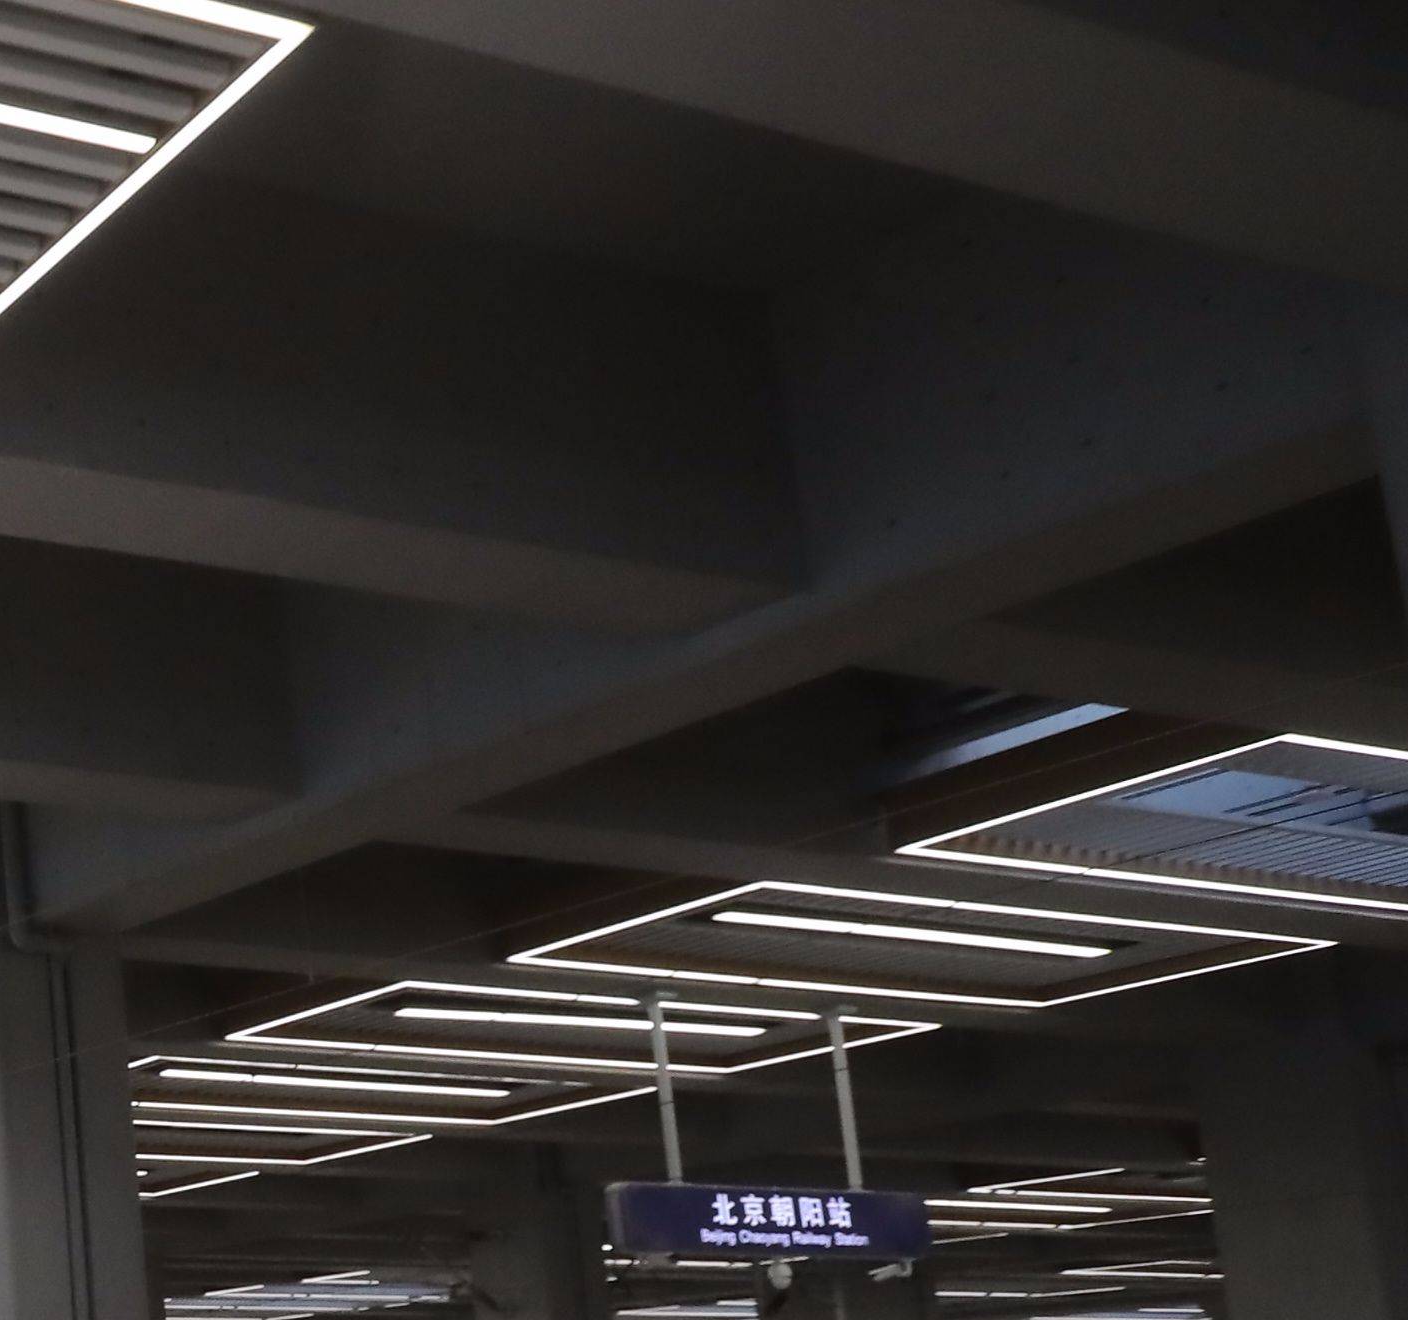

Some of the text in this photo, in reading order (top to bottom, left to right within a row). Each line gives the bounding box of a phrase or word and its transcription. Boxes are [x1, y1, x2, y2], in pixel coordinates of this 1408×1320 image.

[712, 1193, 853, 1229] 北京朝阳站
